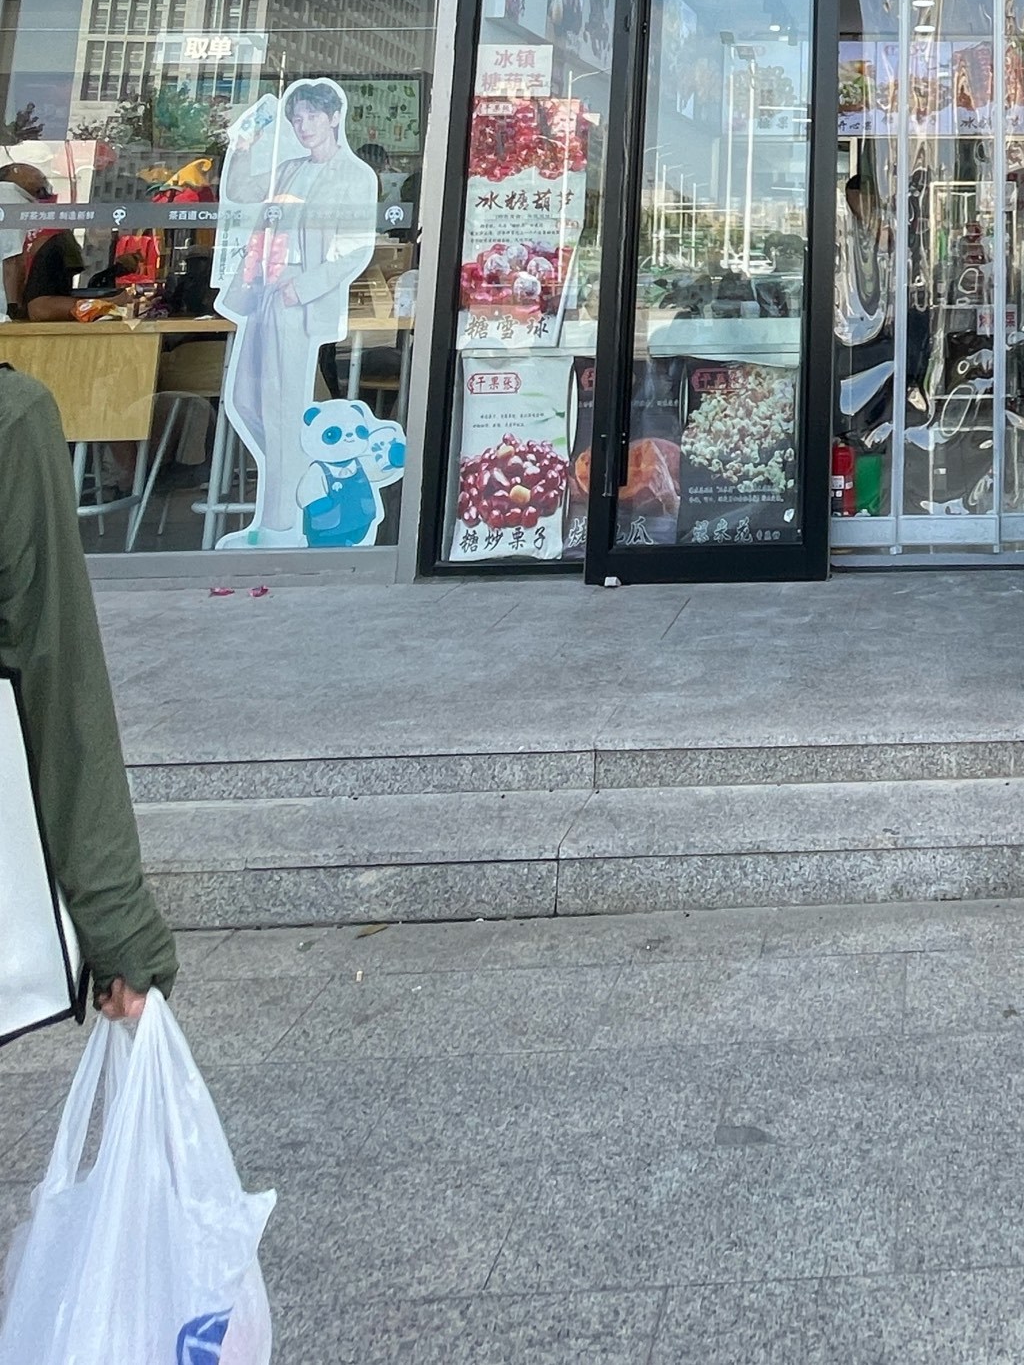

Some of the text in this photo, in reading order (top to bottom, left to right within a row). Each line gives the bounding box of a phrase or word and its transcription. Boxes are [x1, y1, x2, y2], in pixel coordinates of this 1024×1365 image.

[184, 36, 233, 60] 取单
[475, 188, 575, 213] 冰糖葫芦
[464, 315, 550, 340] 糖雪球
[475, 376, 514, 391] 干果张
[459, 526, 547, 554] 糖炒栗子
